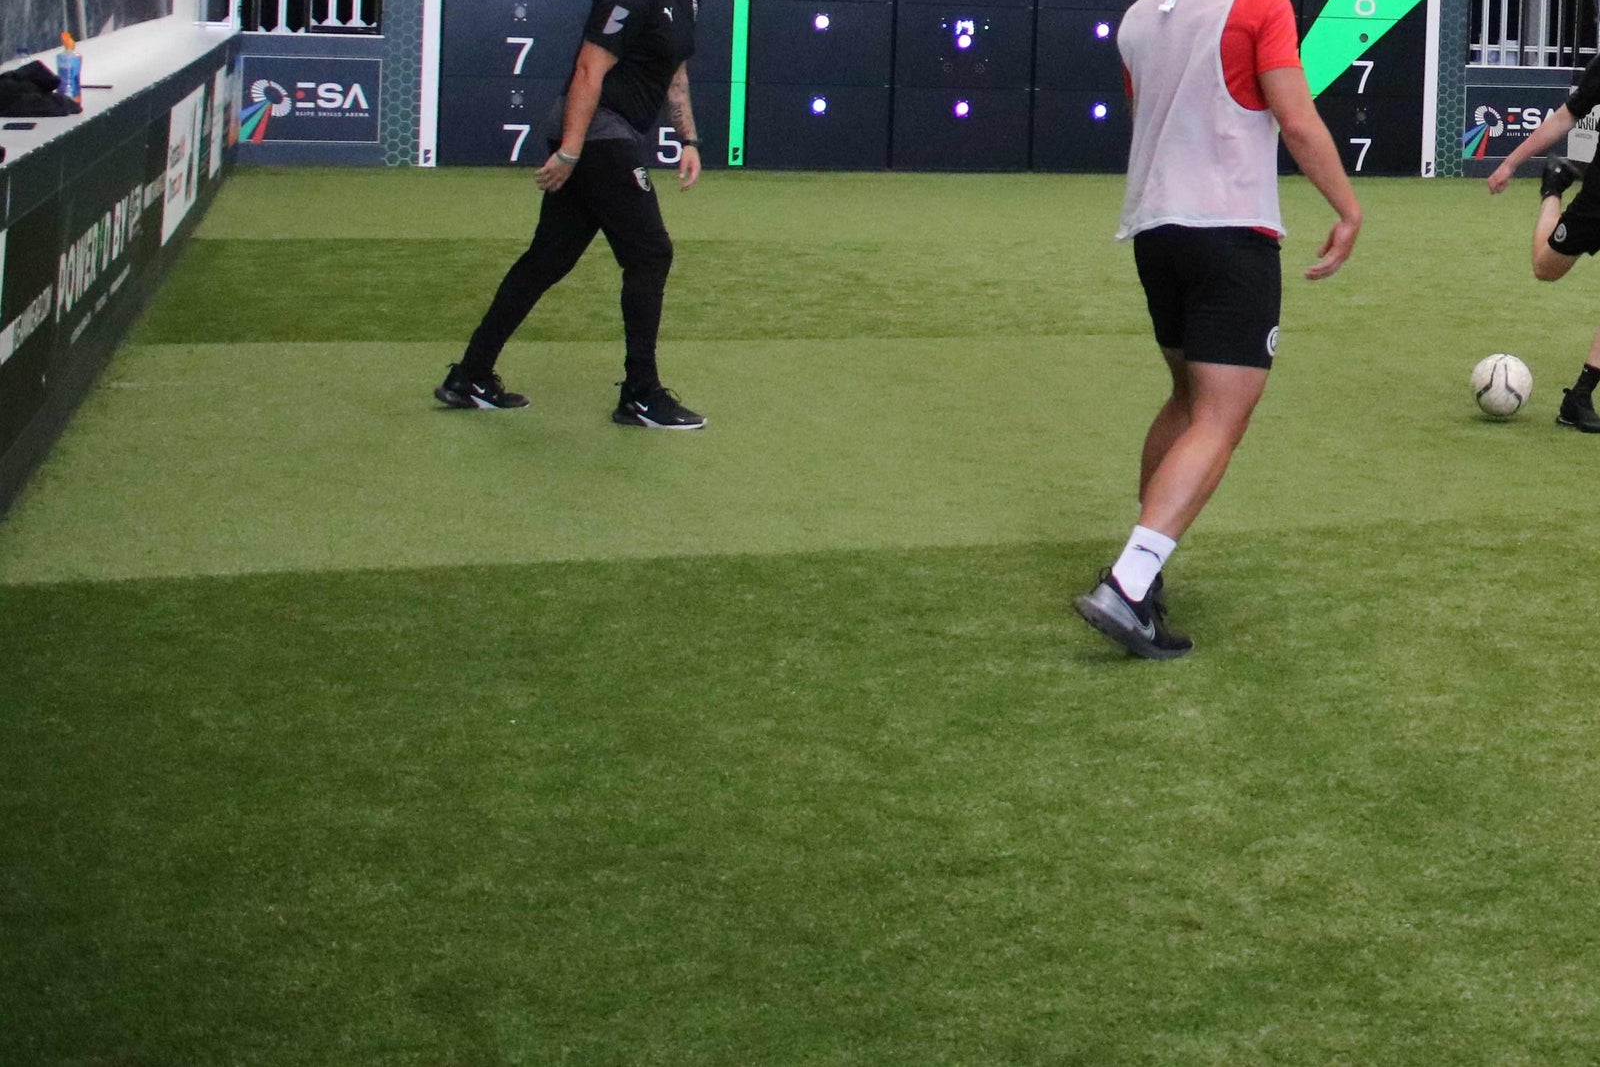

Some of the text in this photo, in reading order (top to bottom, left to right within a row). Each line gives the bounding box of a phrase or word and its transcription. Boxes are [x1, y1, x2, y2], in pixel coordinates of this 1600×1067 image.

[506, 37, 534, 75] 7
[296, 82, 369, 109] ESA
[1352, 61, 1375, 95] 7
[503, 124, 530, 162] 7
[657, 128, 683, 164] 5
[1350, 139, 1372, 172] 7
